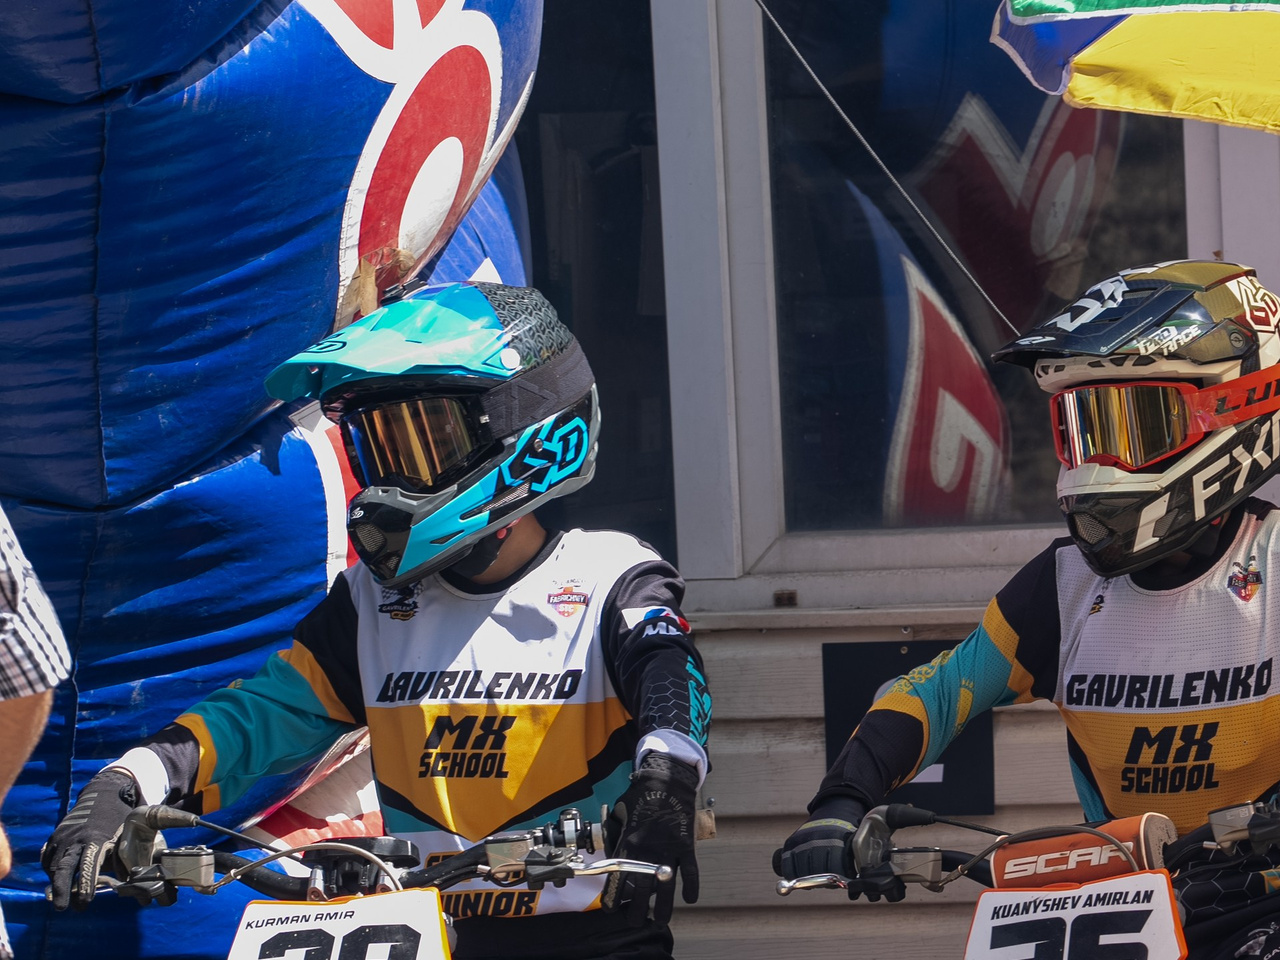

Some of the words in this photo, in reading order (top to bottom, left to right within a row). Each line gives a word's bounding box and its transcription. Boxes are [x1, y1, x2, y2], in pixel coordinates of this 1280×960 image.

[1065, 657, 1274, 709] GAVRILENKO
[424, 715, 518, 751] MX
[1124, 721, 1220, 764] MX
[418, 752, 510, 779] SCHOOL
[1121, 761, 1220, 794] SCHOOL
[1003, 841, 1135, 882] SCAR
[245, 913, 311, 930] KURMAN
[314, 909, 355, 923] AMIR
[441, 891, 540, 921] UNIOR
[990, 895, 1081, 921] KUANYSHEV
[1082, 889, 1155, 908] AMIRLAN
